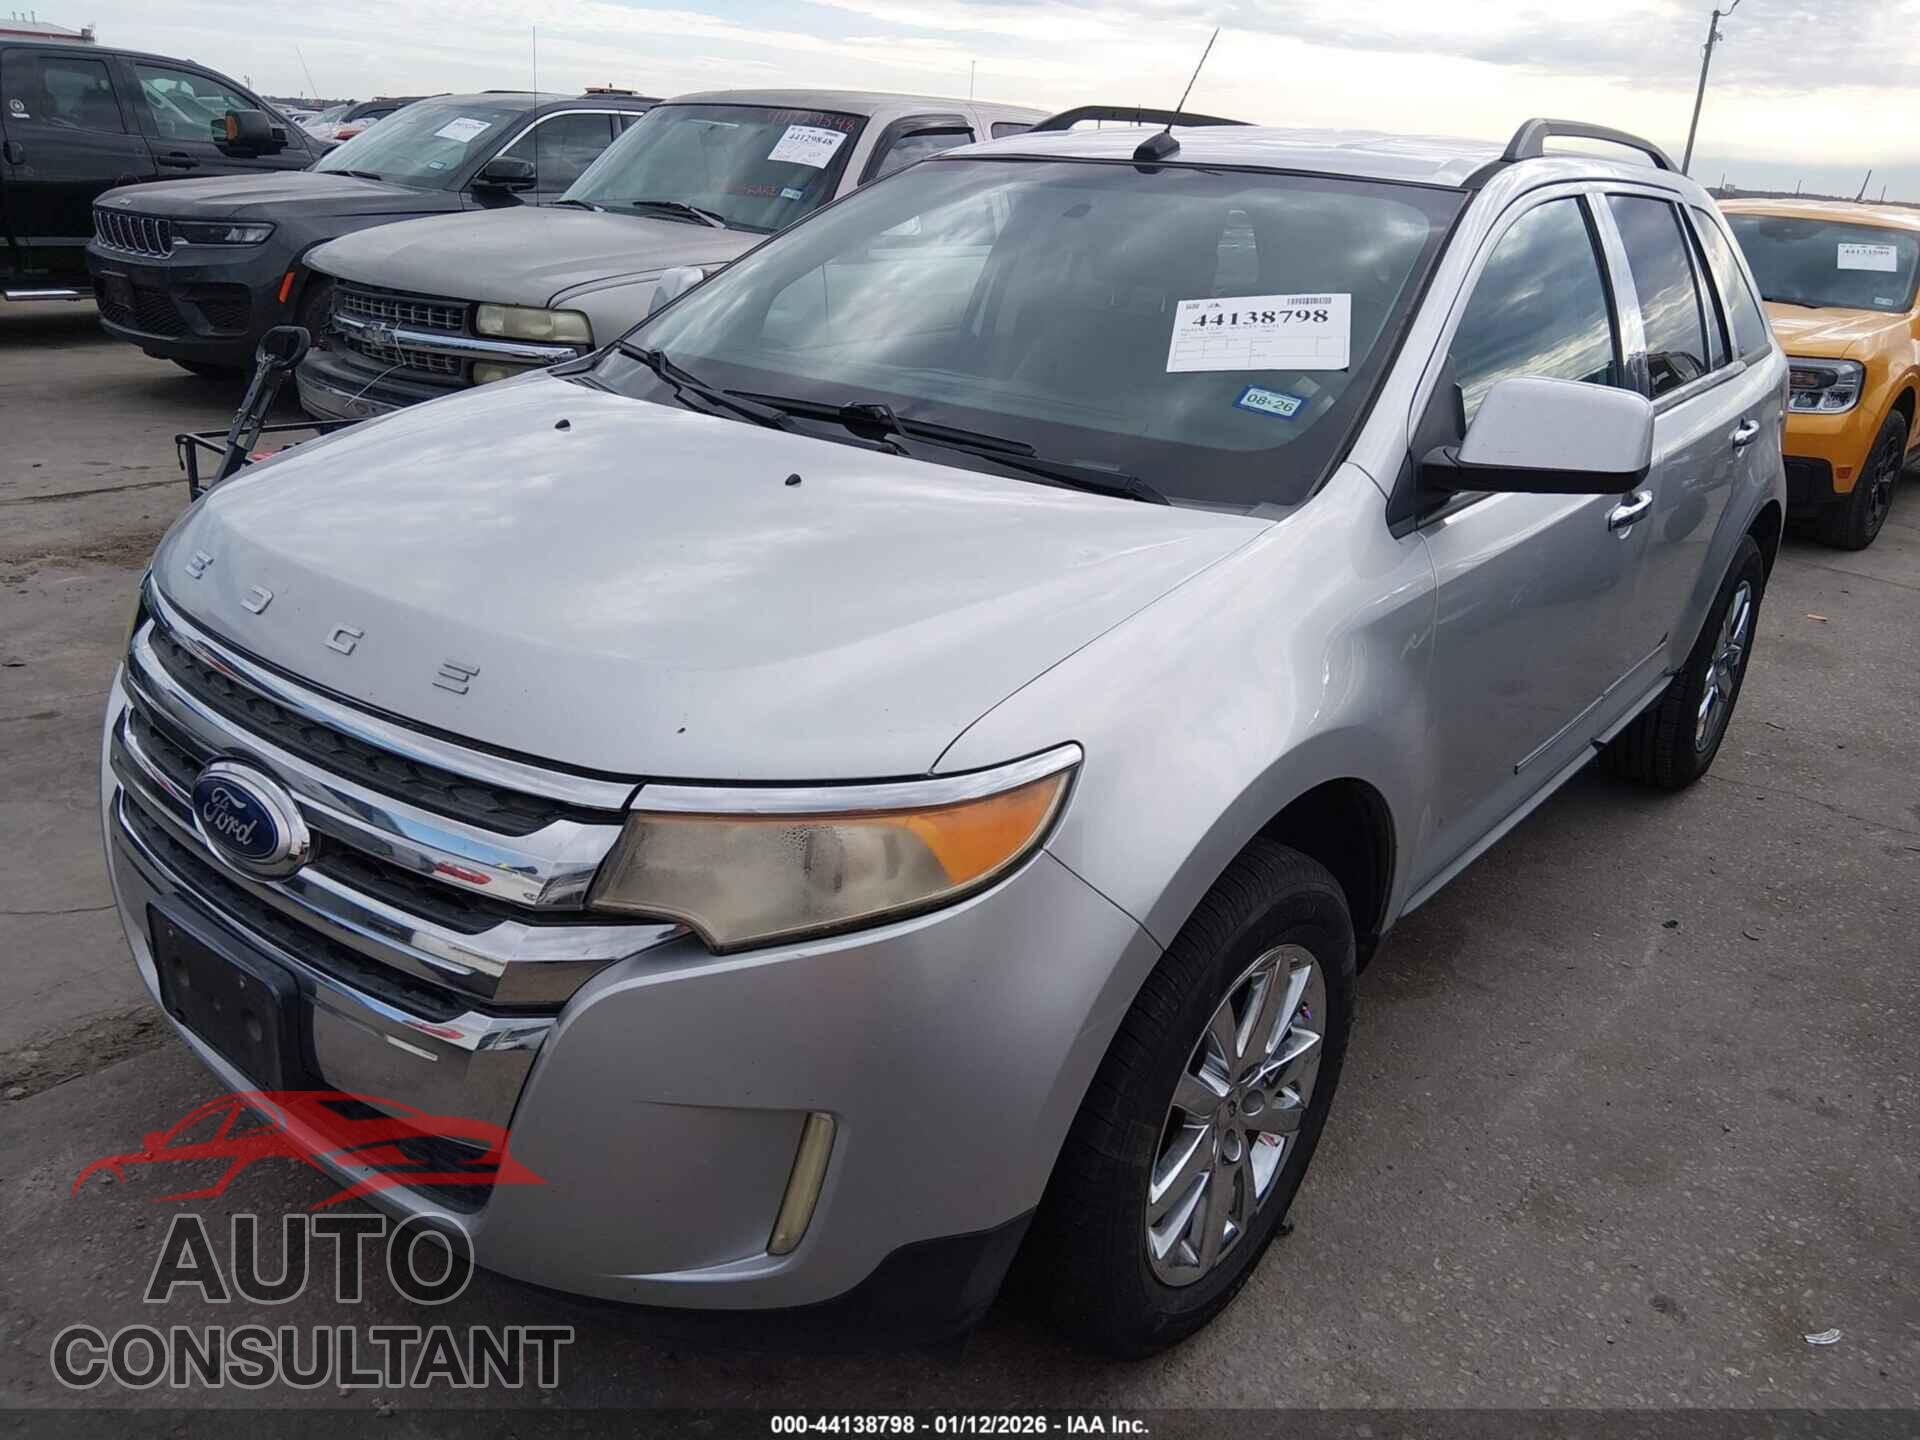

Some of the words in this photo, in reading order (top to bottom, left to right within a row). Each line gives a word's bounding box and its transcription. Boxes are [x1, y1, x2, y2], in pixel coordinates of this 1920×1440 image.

[788, 133, 834, 146] 44129848
[1192, 309, 1329, 327] 44138798
[203, 787, 258, 845] Ford
